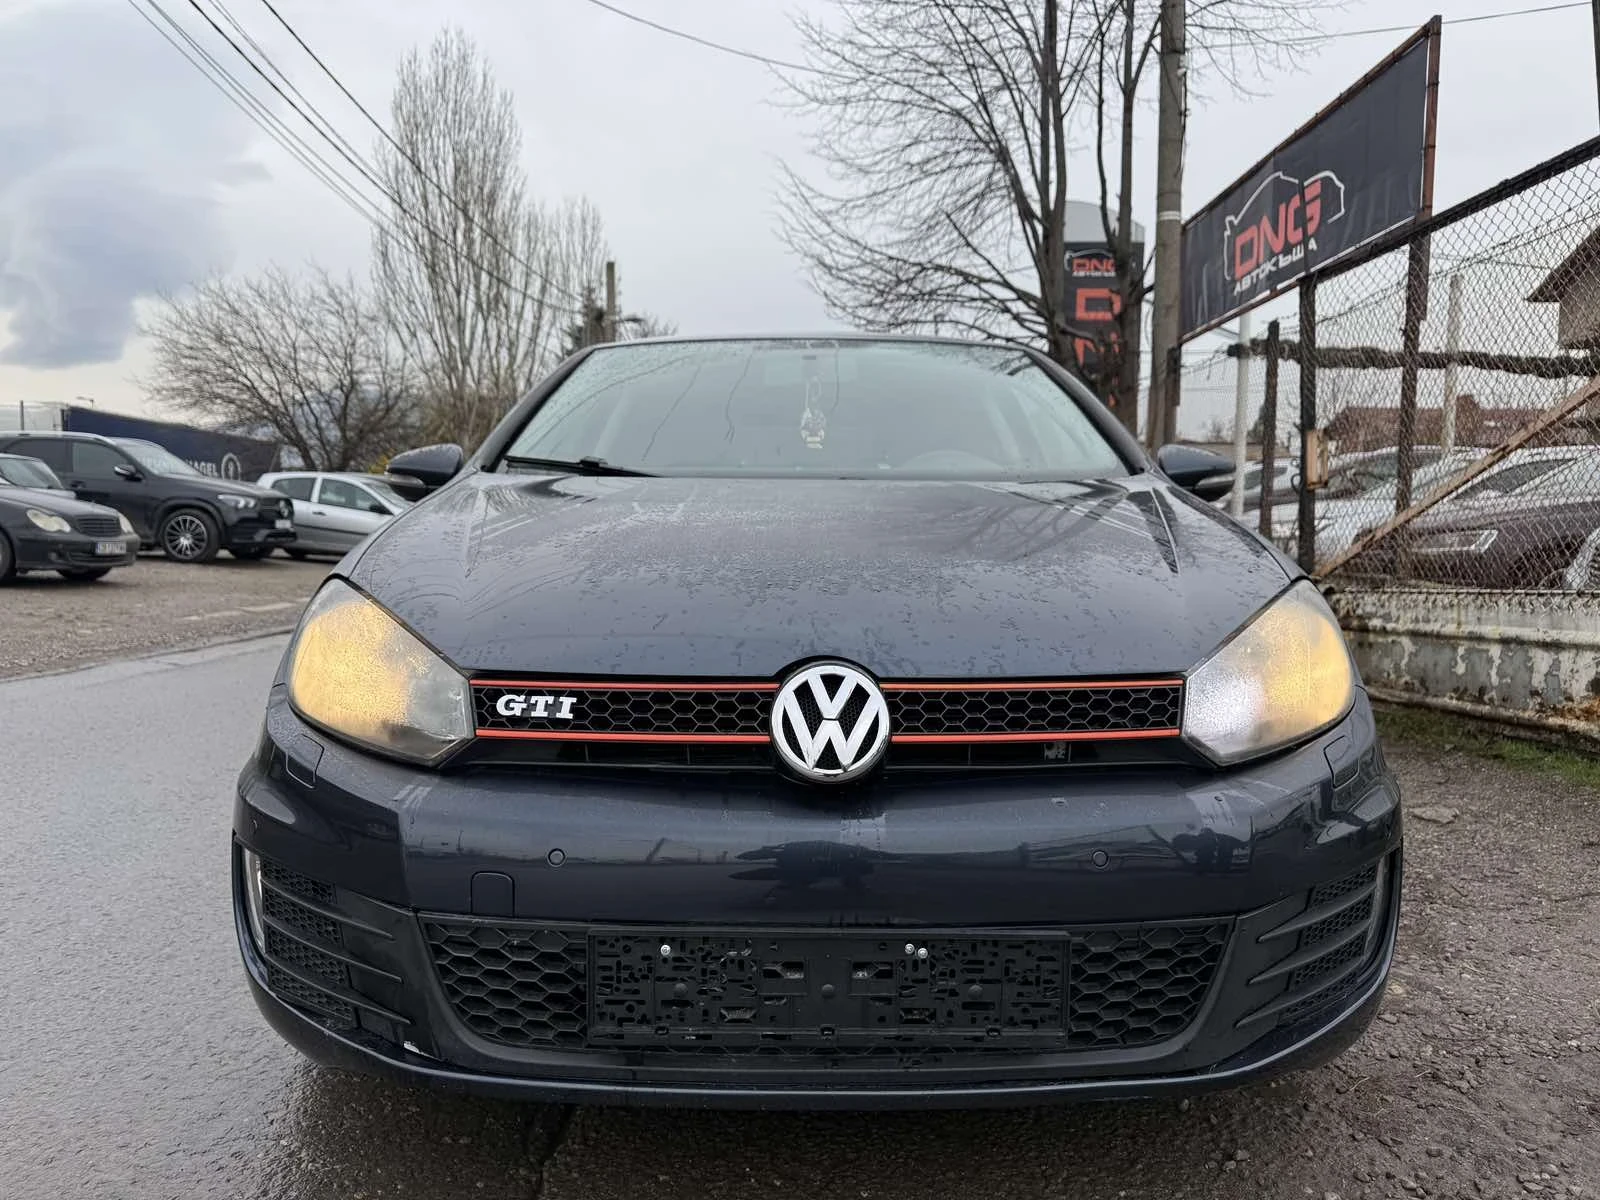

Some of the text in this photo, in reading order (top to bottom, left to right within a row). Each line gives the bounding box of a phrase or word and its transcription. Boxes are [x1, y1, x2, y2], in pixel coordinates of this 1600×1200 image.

[1235, 179, 1322, 280] DNG
[496, 694, 577, 719] GTI
[779, 670, 884, 771] VW
